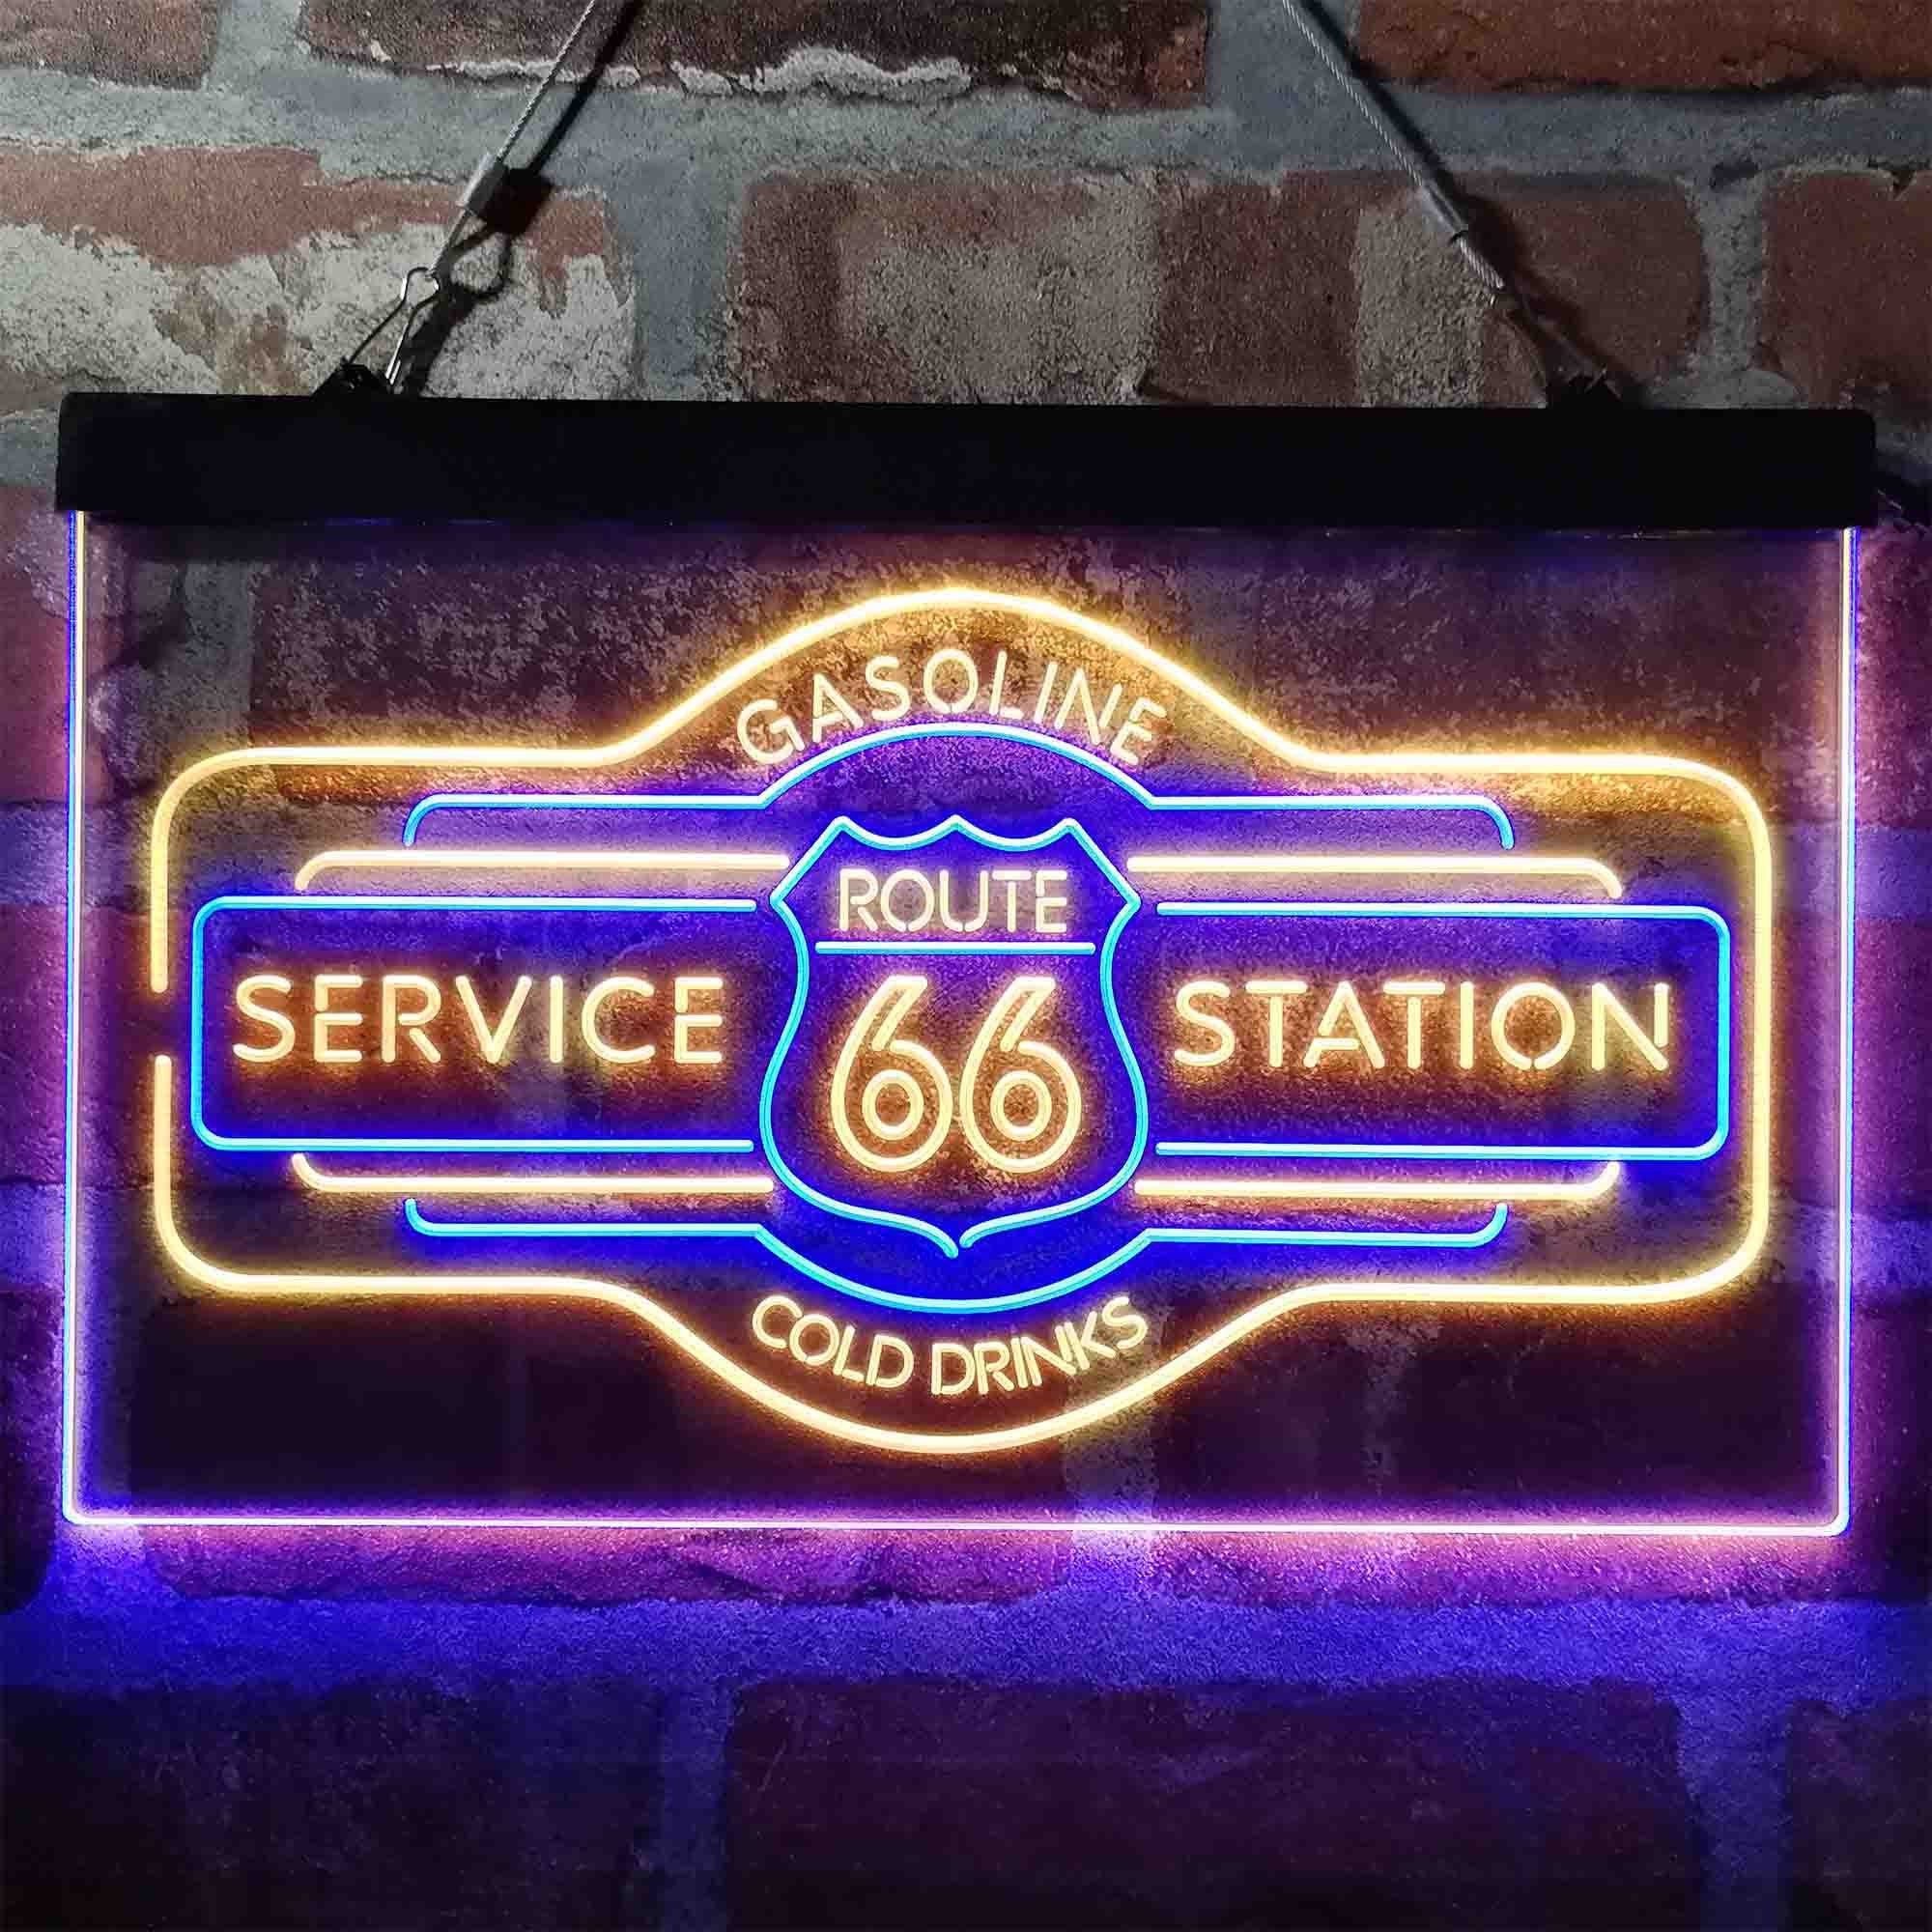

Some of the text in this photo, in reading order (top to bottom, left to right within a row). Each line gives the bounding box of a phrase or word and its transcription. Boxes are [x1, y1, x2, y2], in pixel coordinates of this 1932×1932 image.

[736, 648, 1167, 766] GASOLINE
[838, 868, 1067, 933] ROUTE
[233, 974, 1670, 1070] SERVICE STATION
[830, 975, 1082, 1174] 66
[752, 1293, 1148, 1395] COLD DRINKS
